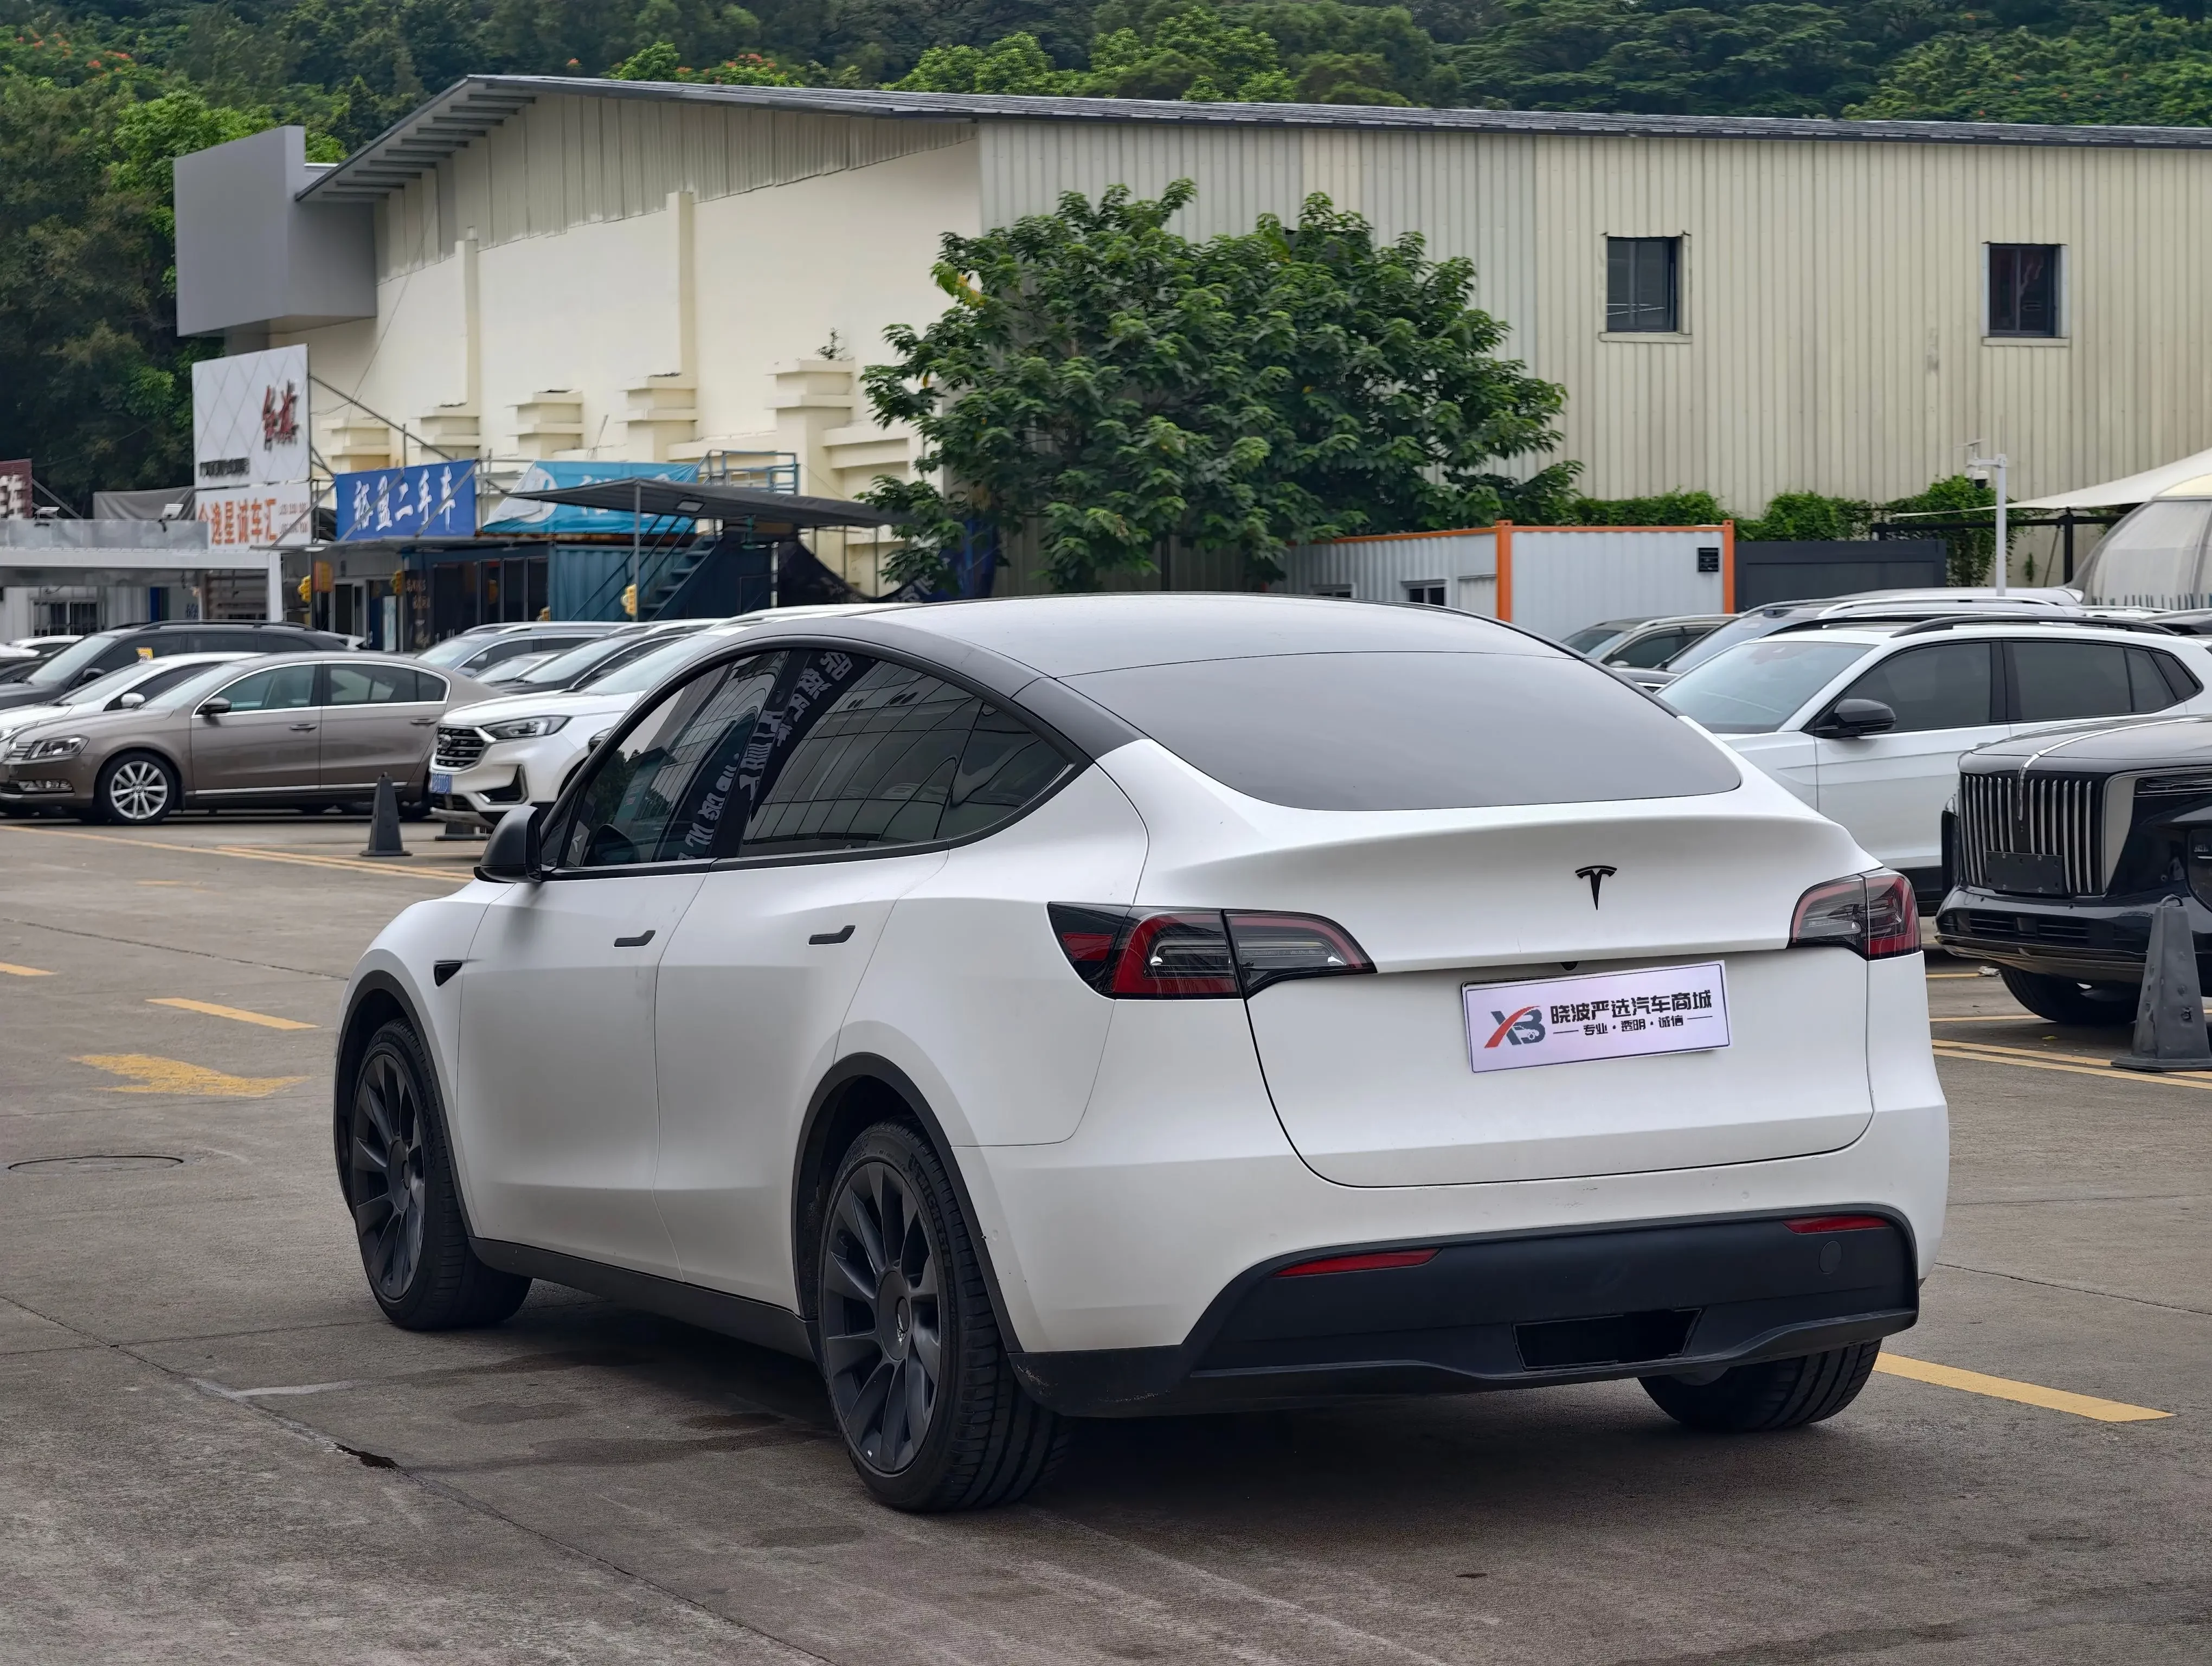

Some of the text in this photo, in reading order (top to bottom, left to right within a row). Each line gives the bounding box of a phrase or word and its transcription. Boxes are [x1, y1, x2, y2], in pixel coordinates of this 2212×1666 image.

[1549, 990, 1712, 1025] 晓波严选汽车商城
[916, 1171, 953, 1267] MICHELIN
